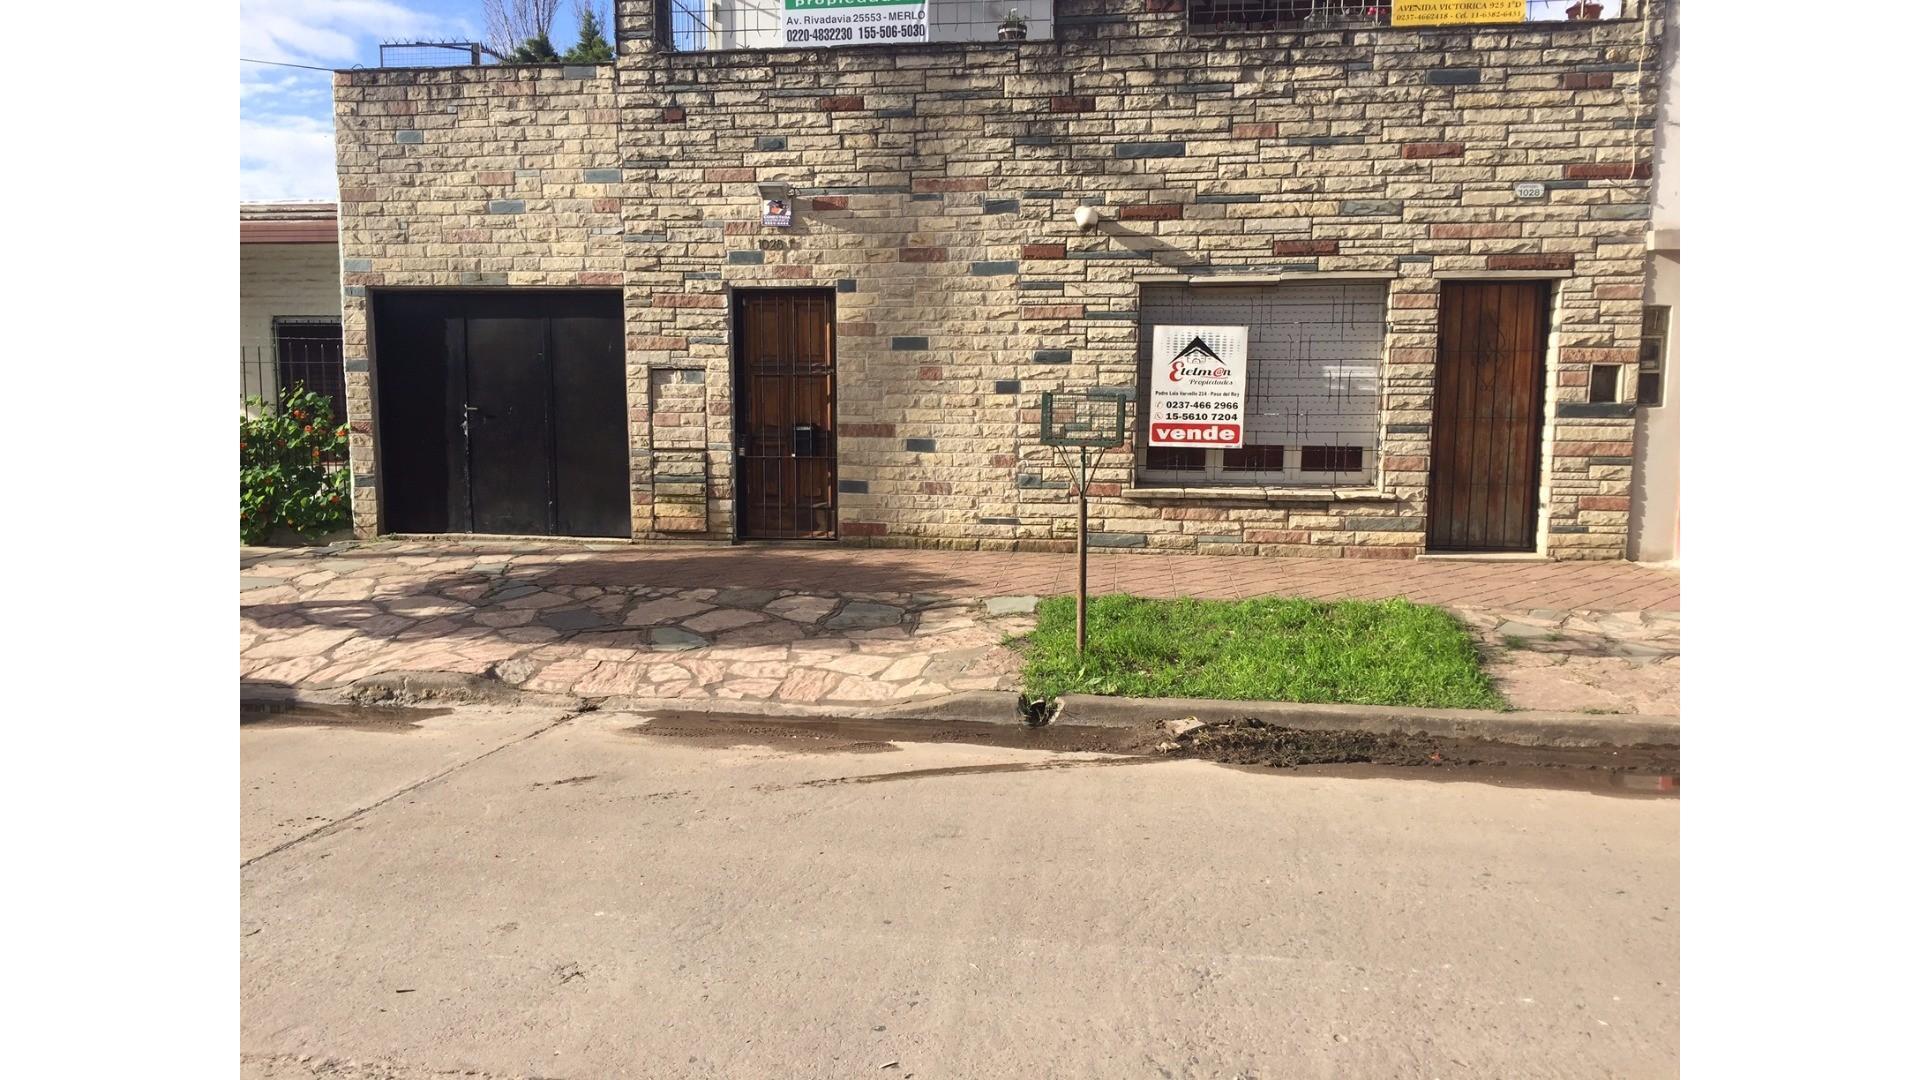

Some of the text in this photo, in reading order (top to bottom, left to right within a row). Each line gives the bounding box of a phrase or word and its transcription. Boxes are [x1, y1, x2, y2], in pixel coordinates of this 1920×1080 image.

[1440, 2, 1487, 10] VICTORICA
[786, 16, 802, 25] Av.
[804, 14, 851, 24] Rivadavia
[853, 13, 882, 23] 25553
[888, 10, 926, 21] MERLO
[786, 24, 926, 42] 0220-4832230 155-506-5030
[1517, 188, 1540, 197] 1028
[1166, 401, 1239, 410] 0237-466 2966
[1166, 412, 1238, 421] 15-5610 7204
[1155, 425, 1235, 441] vende
